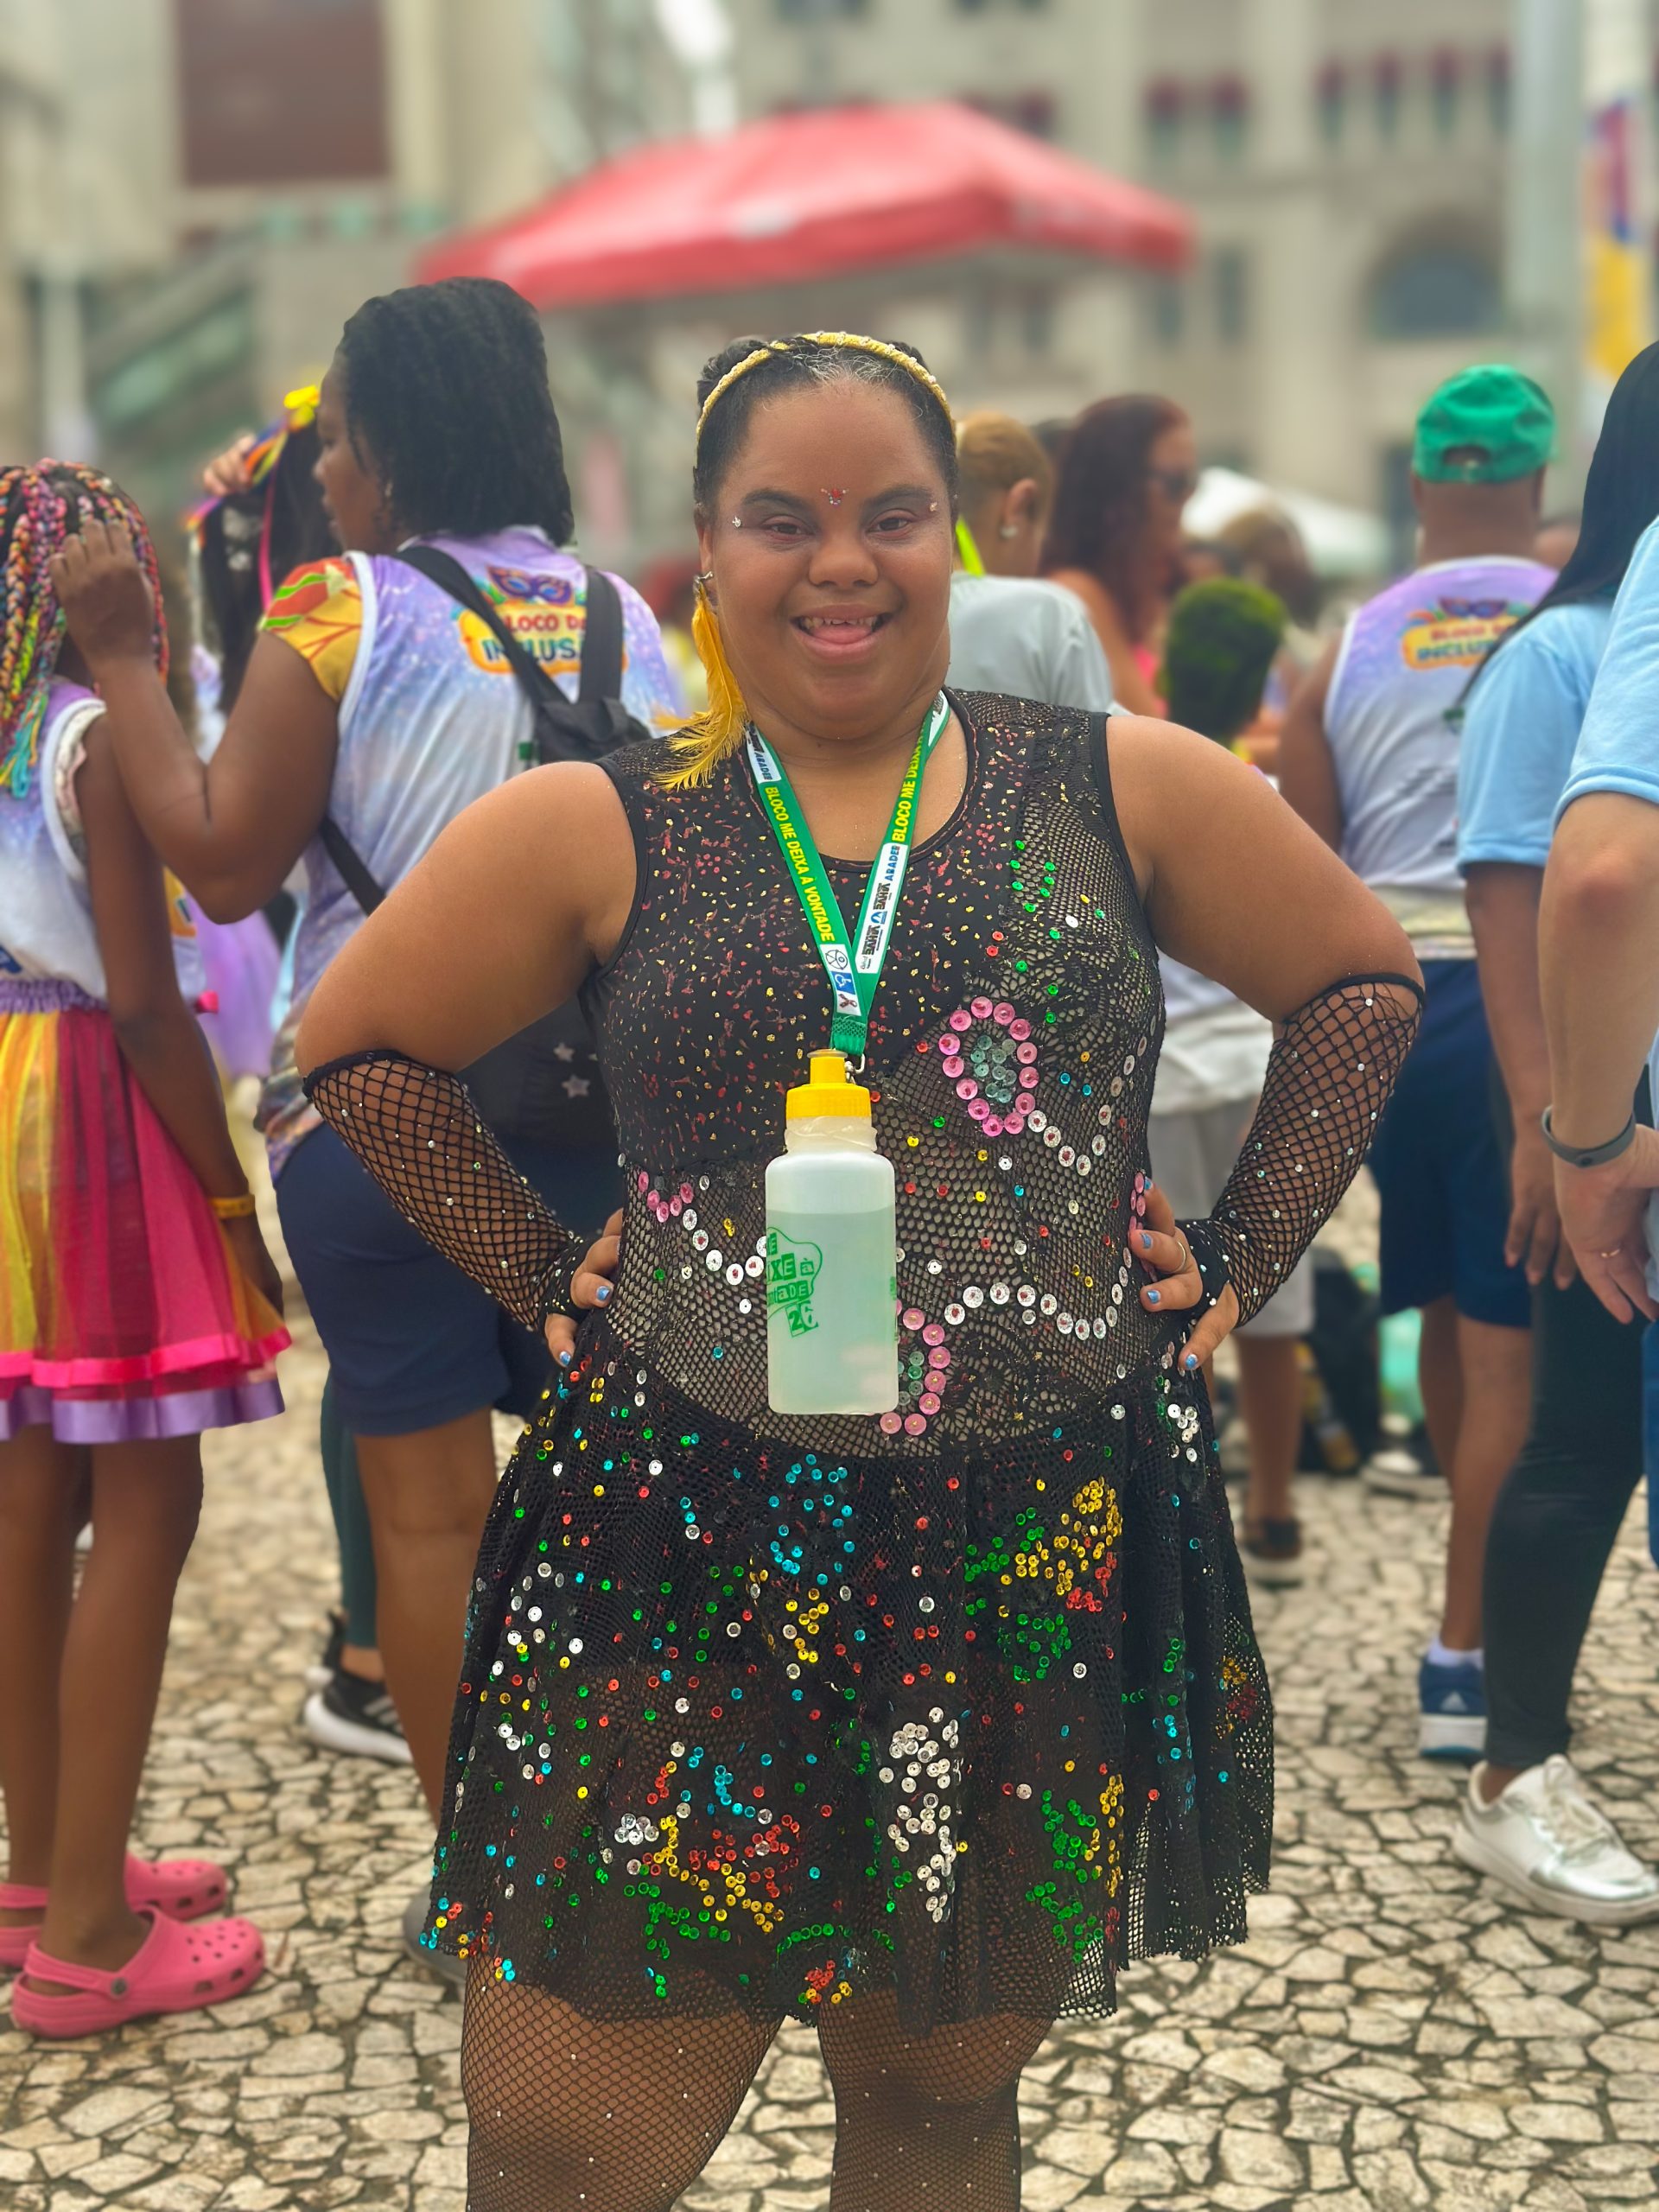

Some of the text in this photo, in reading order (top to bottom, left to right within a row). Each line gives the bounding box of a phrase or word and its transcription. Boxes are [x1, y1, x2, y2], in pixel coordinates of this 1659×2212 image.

[504, 613, 559, 632] LOCO
[765, 787, 789, 822] BLOCO
[900, 780, 916, 799] ME
[779, 823, 797, 840] ME
[892, 800, 912, 842] BLOCO
[786, 841, 810, 874] DEIXA
[804, 887, 836, 942] VONTADE
[787, 1300, 818, 1335] 26
